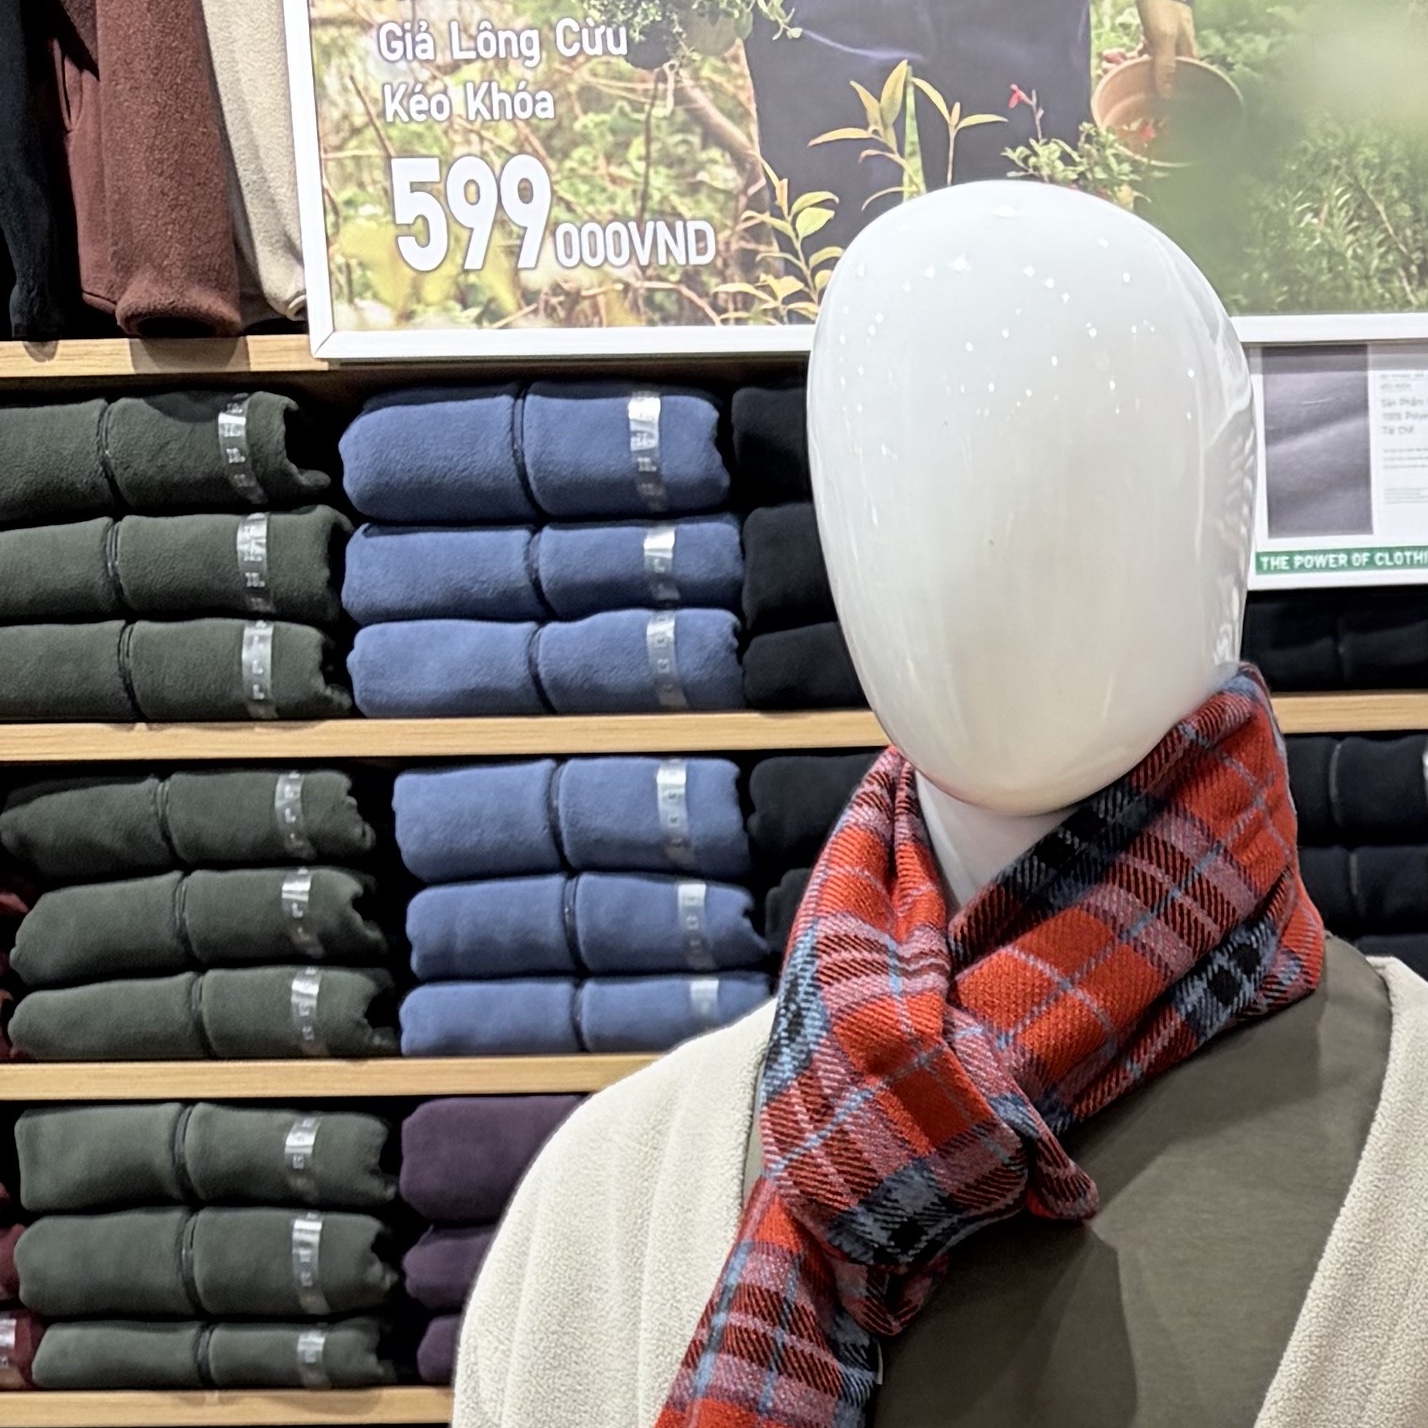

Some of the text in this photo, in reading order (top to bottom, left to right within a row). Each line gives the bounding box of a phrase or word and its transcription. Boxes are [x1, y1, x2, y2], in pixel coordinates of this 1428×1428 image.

[378, 16, 629, 68] Giả Lông Cừu
[383, 80, 556, 123] Kéo Khóa
[1259, 555, 1290, 571] THE
[1293, 552, 1348, 570] POWER
[1351, 552, 1370, 567] OF
